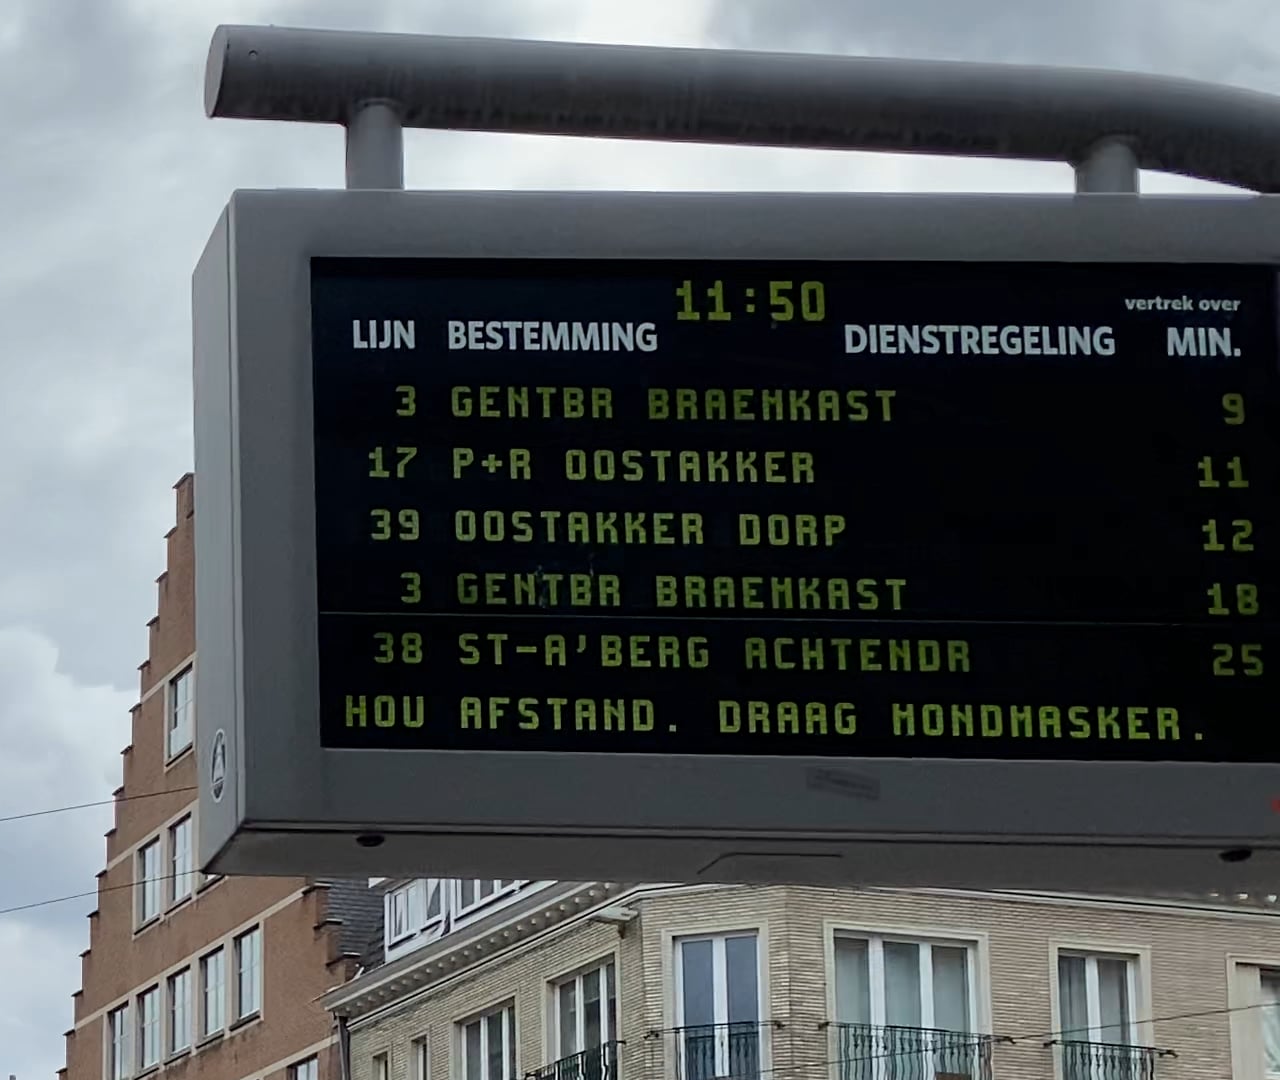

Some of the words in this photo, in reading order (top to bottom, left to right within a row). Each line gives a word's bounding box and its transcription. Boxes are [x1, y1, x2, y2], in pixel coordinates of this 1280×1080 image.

[676, 280, 824, 321] 11:50
[1125, 296, 1193, 311] vertrek
[1199, 300, 1240, 311] over
[353, 320, 415, 349] LIJN
[448, 320, 657, 352] BESTEMMING
[844, 324, 1115, 356] DIENSTREGELING
[1167, 327, 1241, 357] MIN.
[396, 386, 415, 416] 3
[452, 387, 612, 418] GENTBR
[649, 389, 896, 421] BRAEMKAST
[1223, 394, 1244, 424] 9
[369, 447, 417, 478] 17
[453, 448, 531, 479] P+R
[566, 450, 814, 483] OOSTAKKER
[1198, 456, 1248, 487] 11
[371, 509, 419, 540] 39
[455, 510, 703, 544] OOSTAKKER
[739, 514, 845, 546] DORP
[1202, 519, 1253, 551] 12
[401, 573, 420, 603] 3
[458, 572, 620, 606] GENTBR
[656, 576, 906, 610] BRAEMKAST
[1208, 583, 1258, 614] 18
[375, 633, 422, 663] 38
[746, 638, 969, 672] ACHTENDR
[1214, 645, 1262, 675] 25
[346, 696, 424, 727] HOU
[461, 697, 676, 732] AFSTAND.
[719, 701, 856, 734] DRAAG
[893, 704, 1202, 740] MONDMASKER.
